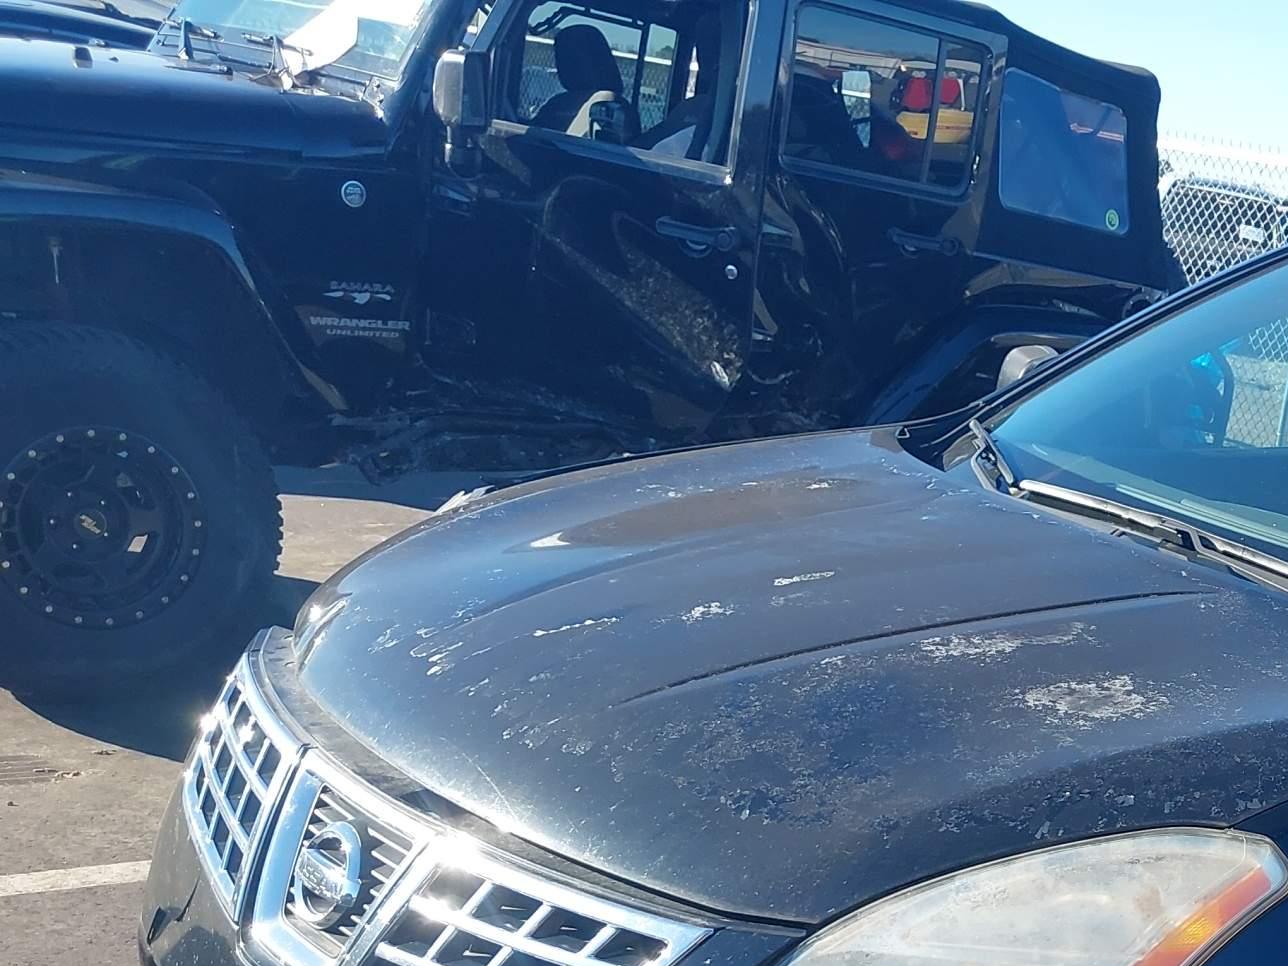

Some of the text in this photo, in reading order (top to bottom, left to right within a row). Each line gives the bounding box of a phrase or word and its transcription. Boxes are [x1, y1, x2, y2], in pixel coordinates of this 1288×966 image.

[329, 280, 395, 293] SAHARA
[309, 316, 411, 330] WRANGLER
[325, 328, 400, 338] UNLIMITED
